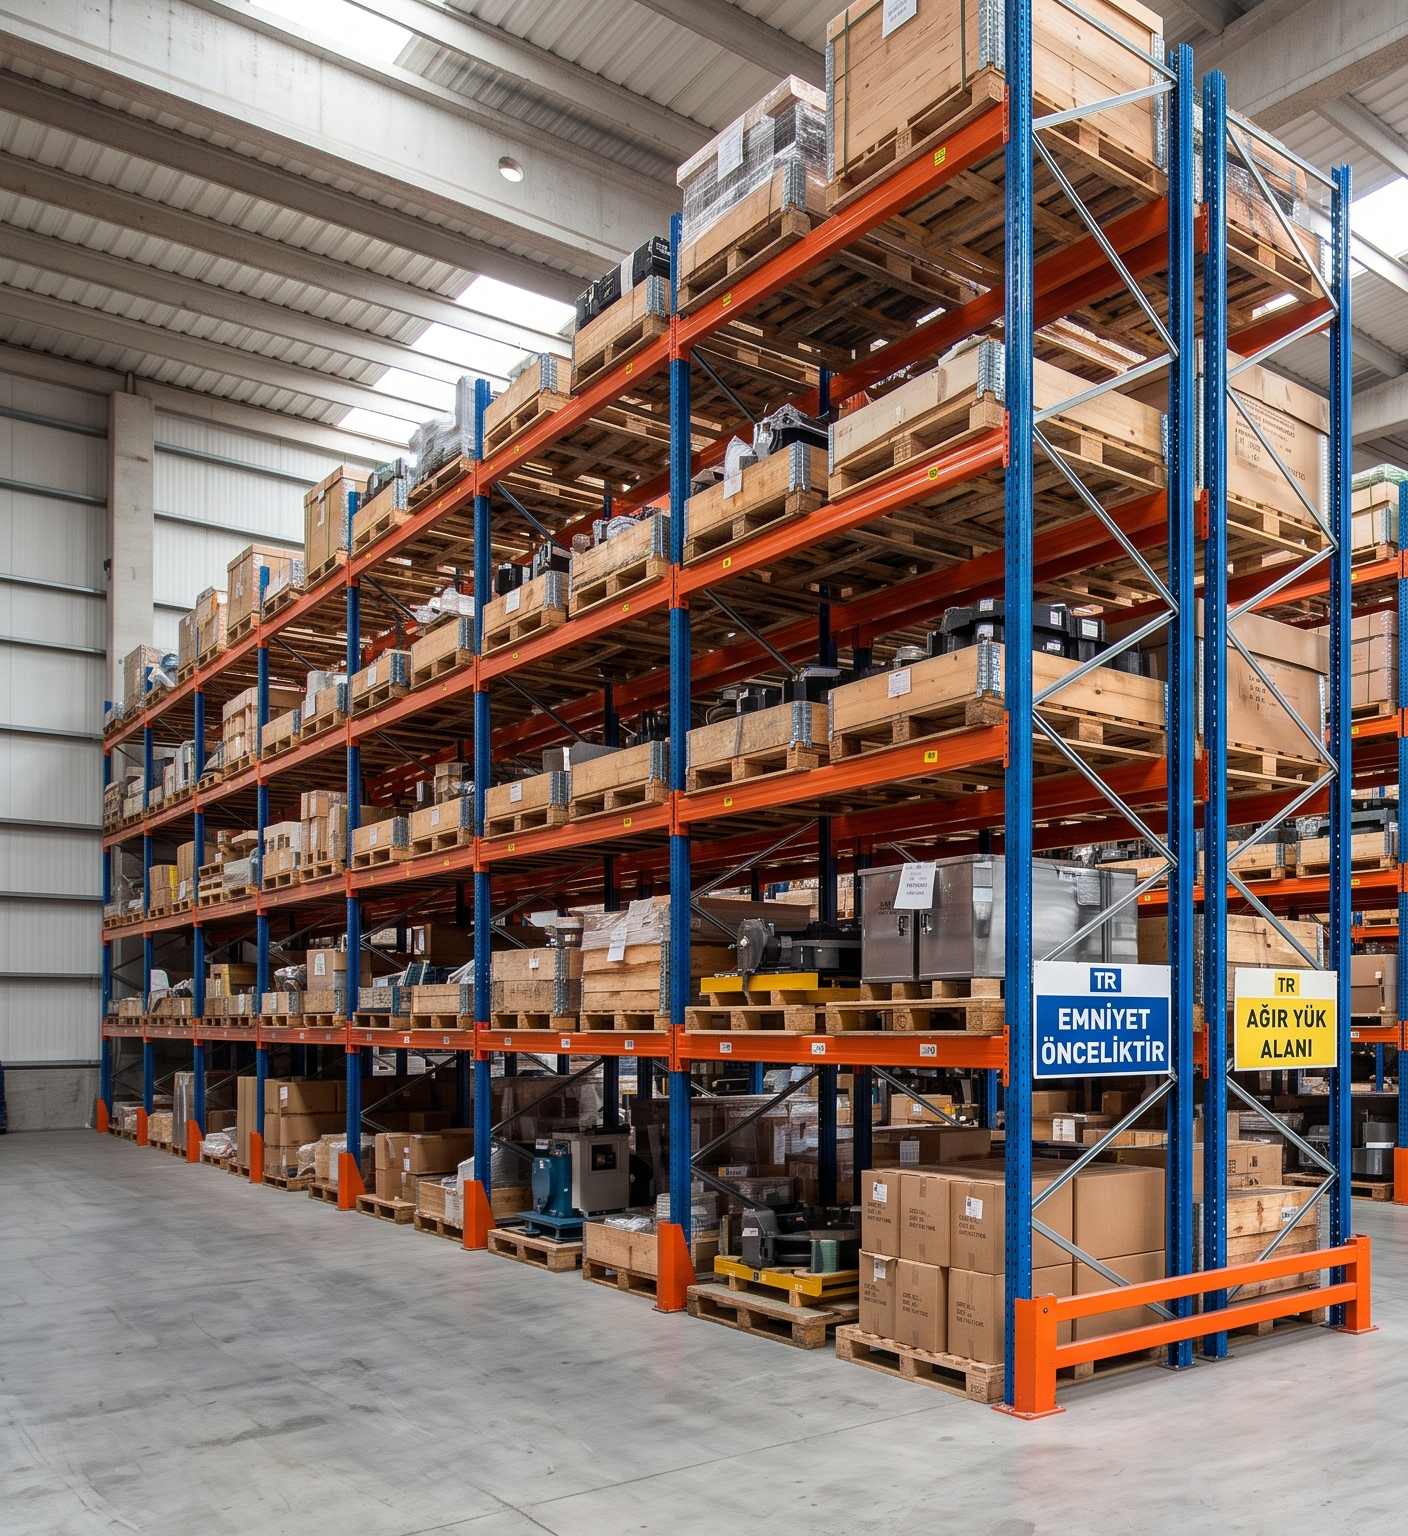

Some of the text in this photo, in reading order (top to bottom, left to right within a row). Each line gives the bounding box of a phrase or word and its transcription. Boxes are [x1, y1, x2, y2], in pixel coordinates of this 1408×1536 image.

[1094, 972, 1117, 989] TR
[1278, 977, 1295, 992] TR
[1058, 1003, 1151, 1030] EMNİYET
[1246, 1004, 1326, 1028] AĞIR YÜK
[1041, 1035, 1165, 1065] ÖNCELİKTİR
[1260, 1039, 1312, 1058] ALANI
